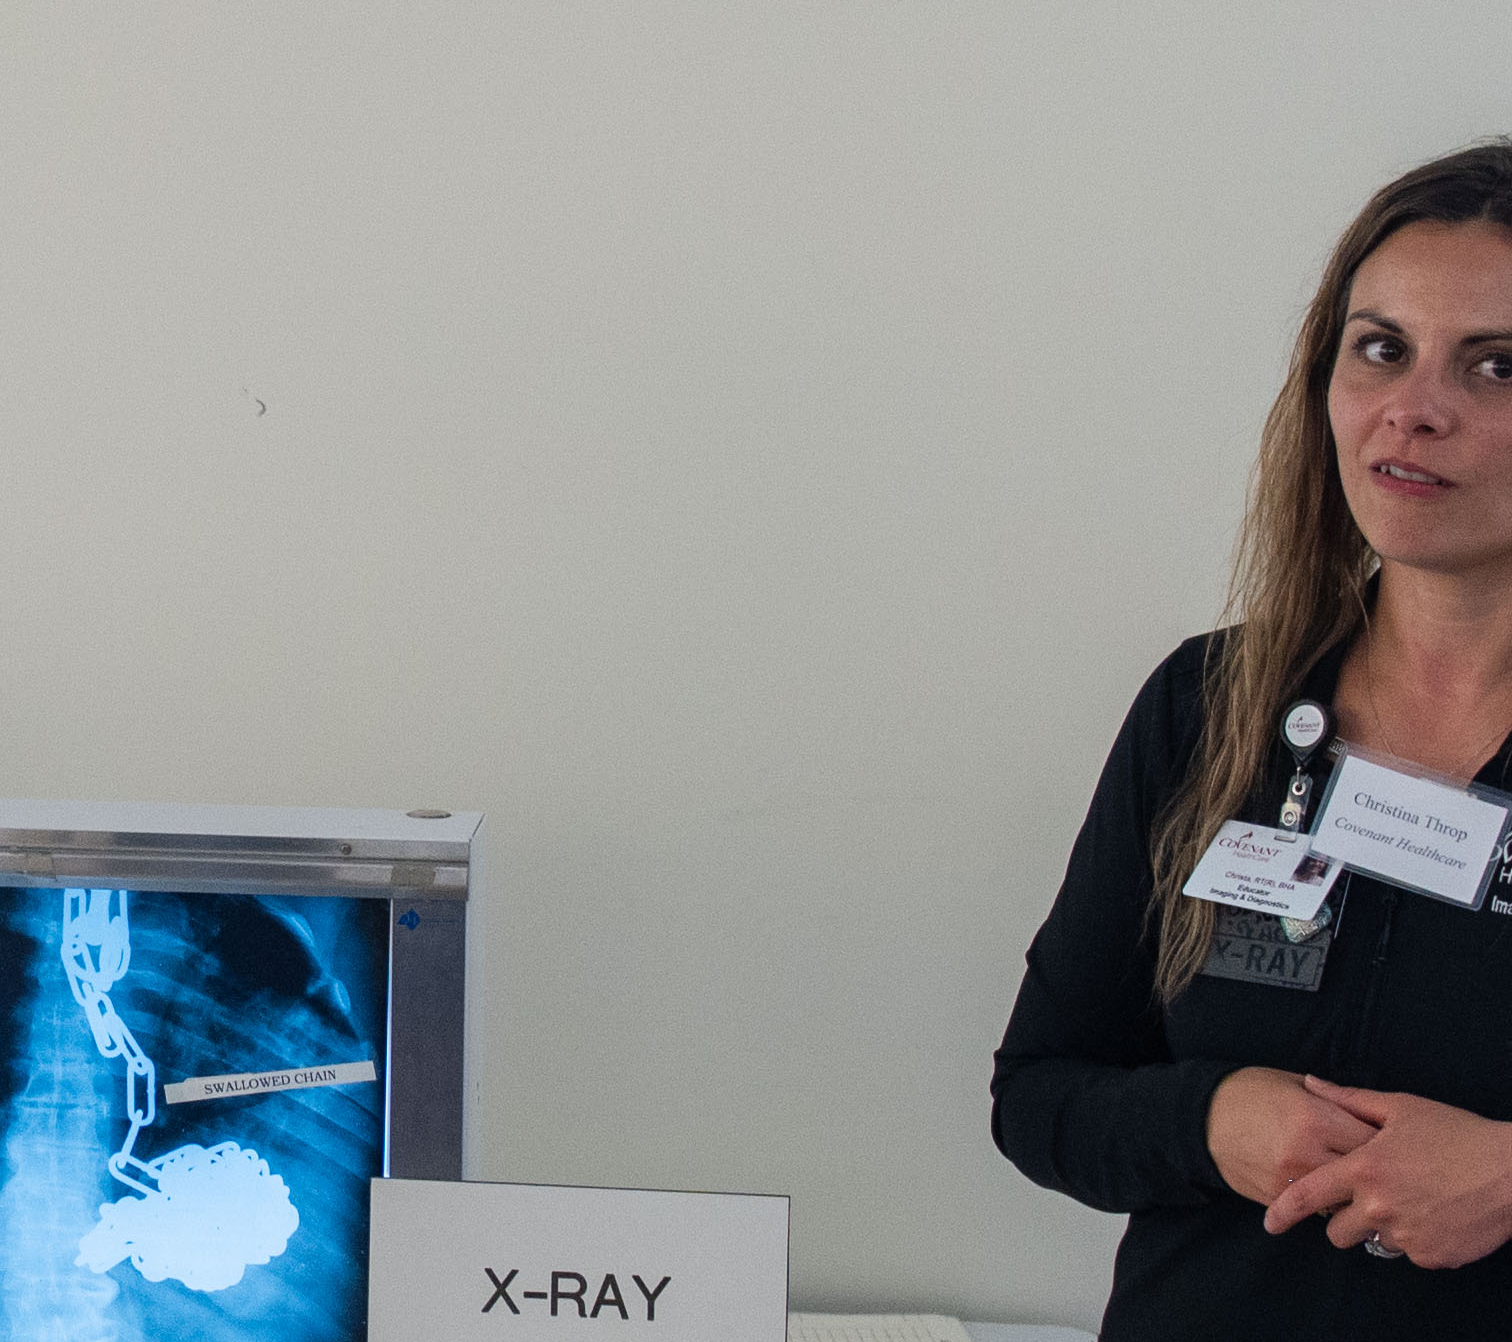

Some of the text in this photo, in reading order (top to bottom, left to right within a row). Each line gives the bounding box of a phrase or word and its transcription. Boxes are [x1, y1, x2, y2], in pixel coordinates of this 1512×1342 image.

[1354, 791, 1468, 843] Christina Throp
[1218, 835, 1282, 857] COVENANT
[1335, 816, 1467, 871] Covenant Healthcare
[1209, 887, 1238, 901] Imaging
[1247, 894, 1290, 910] Diagnostics
[1236, 885, 1271, 896] Educator
[204, 1069, 337, 1095] SWALLOWED CHAIN
[481, 1267, 671, 1322] X-RAY
